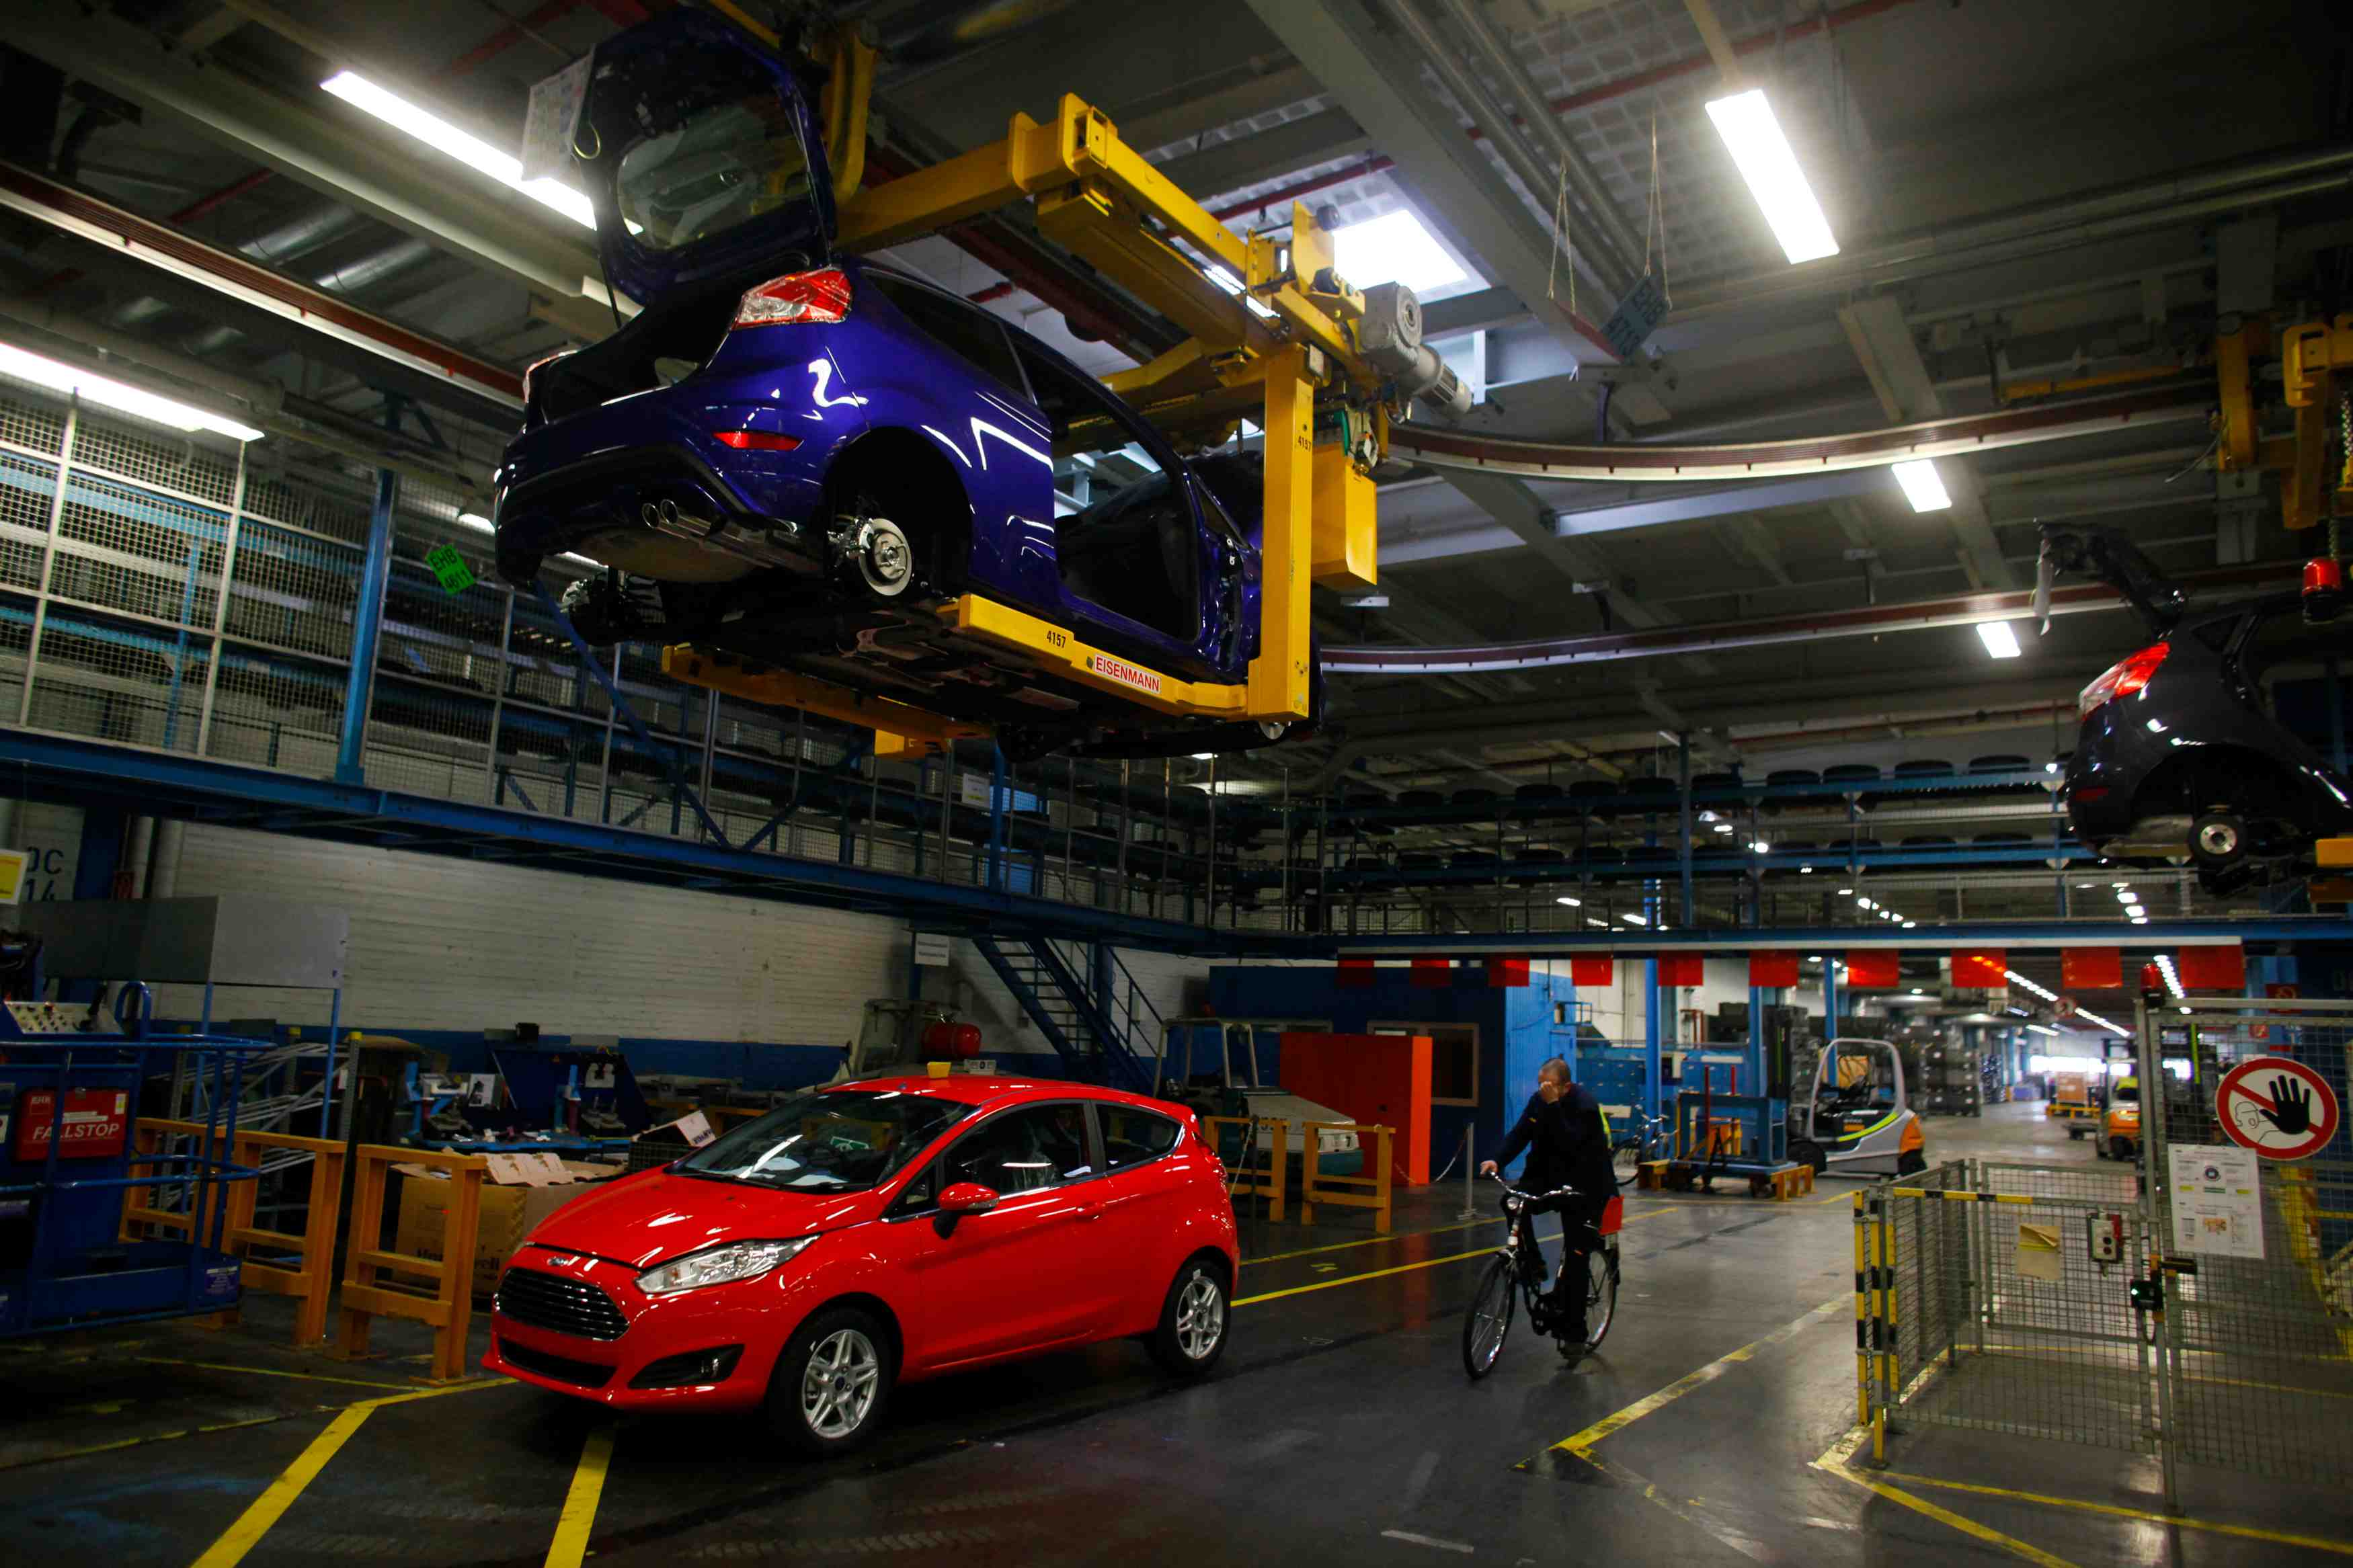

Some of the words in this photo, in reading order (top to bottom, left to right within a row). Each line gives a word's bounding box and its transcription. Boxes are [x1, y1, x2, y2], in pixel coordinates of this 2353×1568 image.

[1298, 436, 1312, 452] 4157
[430, 548, 458, 571] EHB
[1046, 630, 1066, 648] 4157
[1096, 656, 1160, 692] EISENMANN
[32, 1123, 120, 1141] FALSTOP
